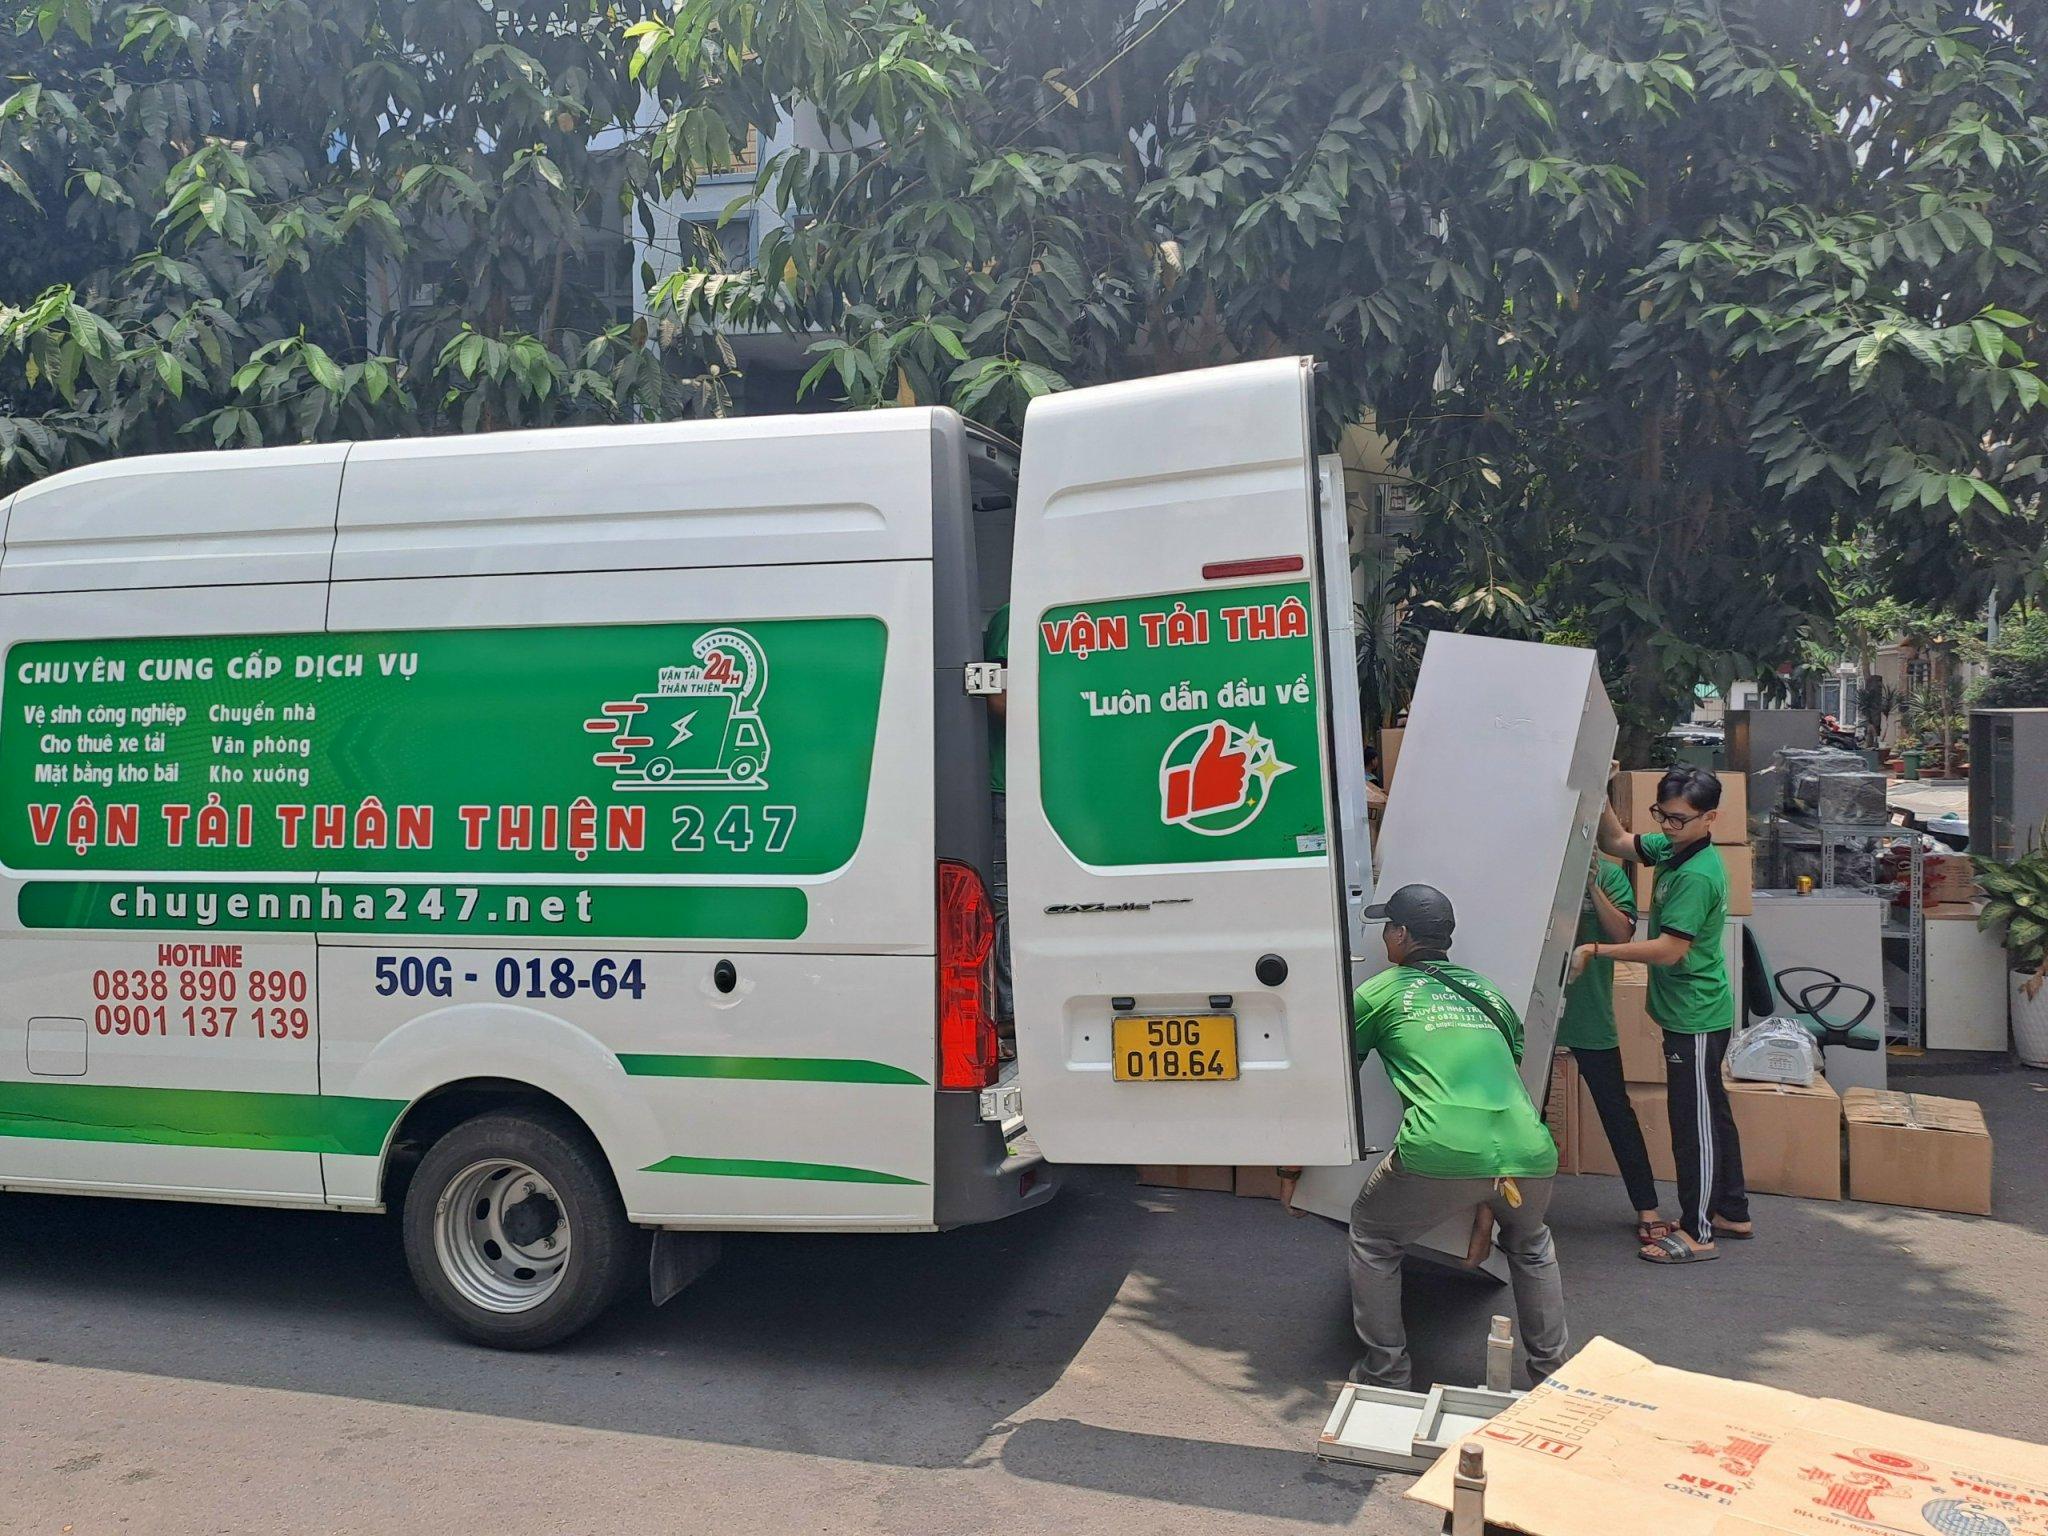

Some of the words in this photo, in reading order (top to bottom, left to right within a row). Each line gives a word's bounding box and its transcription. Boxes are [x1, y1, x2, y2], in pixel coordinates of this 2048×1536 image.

[1041, 612, 1128, 660] VẬN
[1140, 602, 1209, 647] TẢI
[1221, 596, 1308, 642] THÂ
[18, 656, 125, 684] CHUYÊN
[139, 657, 214, 680] CUNG
[227, 649, 282, 679] CẤP
[295, 653, 363, 683] DỊCH
[378, 653, 419, 682] VỤ
[661, 668, 681, 684] VẬN
[684, 668, 701, 681] TẢI
[660, 682, 688, 694] THÂN
[691, 681, 721, 695] THIỆN
[1160, 680, 1208, 712] dẫn
[1217, 678, 1266, 709] đầu
[1275, 674, 1310, 705] về
[24, 706, 46, 729] Vệ
[51, 704, 82, 724] sinh
[87, 703, 126, 727] công
[131, 703, 187, 727] nghiệp
[209, 700, 275, 726] Chuyển
[283, 703, 316, 721] nhà
[40, 735, 71, 753] Cho
[77, 733, 113, 753] thuê
[118, 737, 139, 753] xe
[145, 732, 165, 753] tải
[211, 736, 245, 754] Văn
[252, 735, 311, 758] phòng
[34, 764, 68, 787] Mặt
[73, 761, 113, 787] bằng
[118, 763, 149, 783] kho
[154, 762, 179, 783] bãi
[209, 765, 244, 783] Kho
[28, 795, 139, 856] VẬN
[162, 792, 253, 848] TẢI
[276, 796, 433, 850] THÂN
[459, 796, 645, 861] THIỆN
[671, 805, 797, 852] 247
[109, 886, 594, 926] chuyennha247.net
[157, 944, 242, 969] HOTLINE
[93, 969, 168, 1003] 0838
[179, 970, 237, 1003] 890
[247, 970, 307, 1003] 890
[375, 956, 452, 997] 50G
[495, 956, 646, 1000] 018-64
[95, 1004, 167, 1036] 0901
[182, 1005, 238, 1038] 137
[251, 1007, 309, 1039] 139
[1148, 1020, 1200, 1046] 50G
[1127, 1050, 1223, 1077] 018.64
[1575, 1388, 1597, 1397] IN
[1601, 1395, 1658, 1411] MADE
